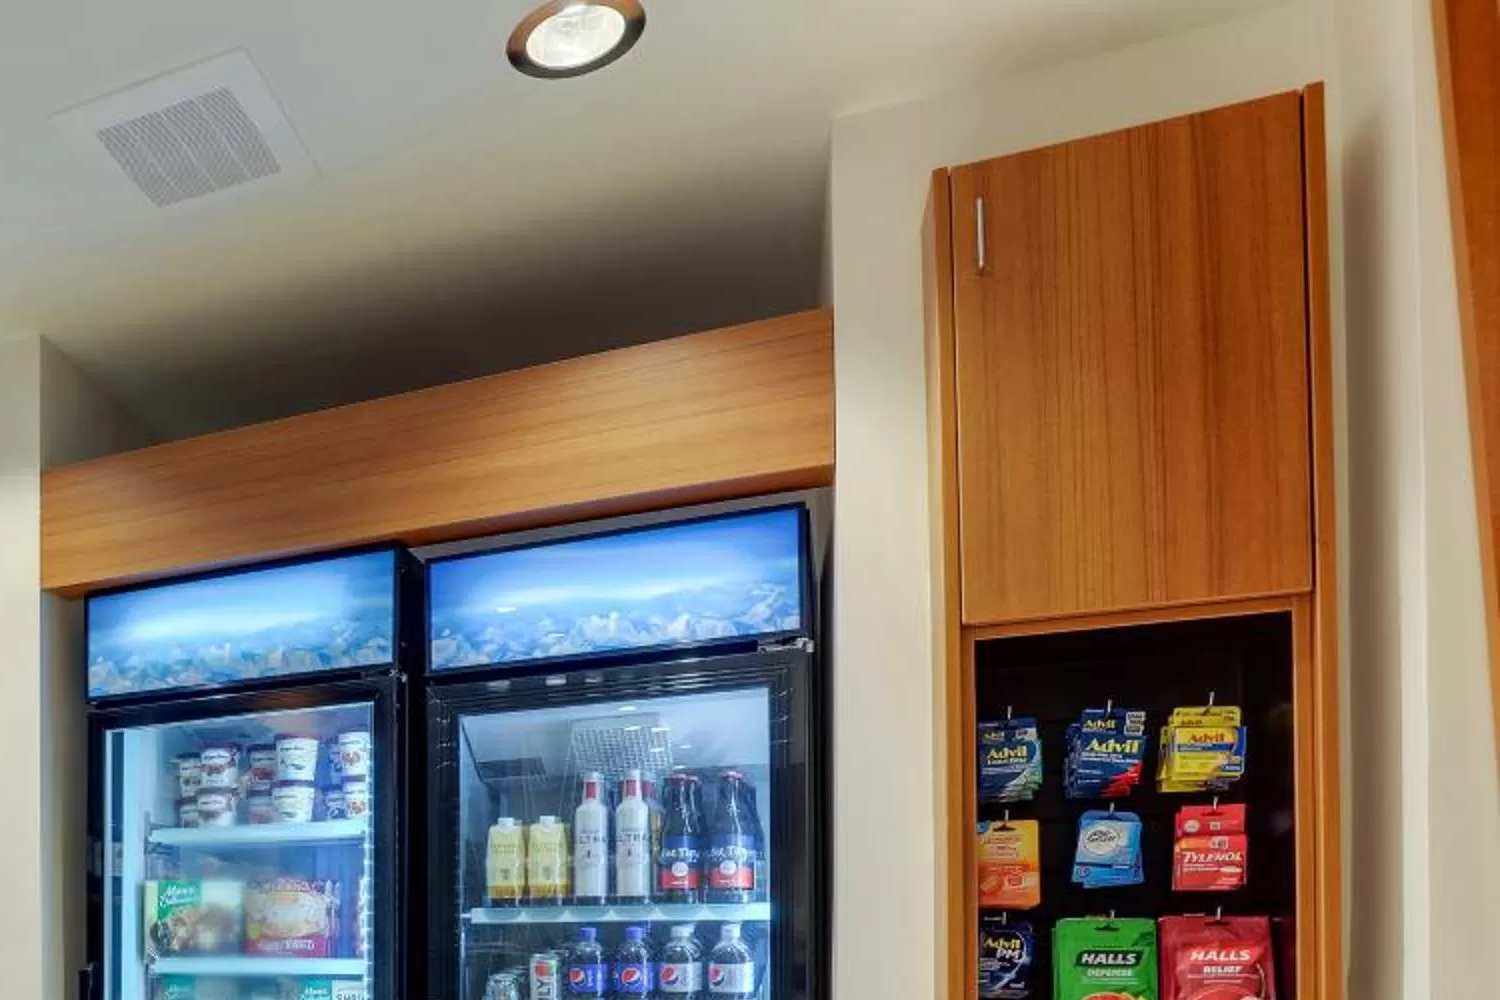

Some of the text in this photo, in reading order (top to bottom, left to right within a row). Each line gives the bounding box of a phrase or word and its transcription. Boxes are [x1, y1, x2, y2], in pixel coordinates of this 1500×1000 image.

[1085, 737, 1140, 753] Advil
[987, 745, 1029, 760] Advil
[984, 937, 1022, 950] Advil
[1081, 952, 1137, 965] HALLS
[1189, 949, 1252, 961] HALLS
